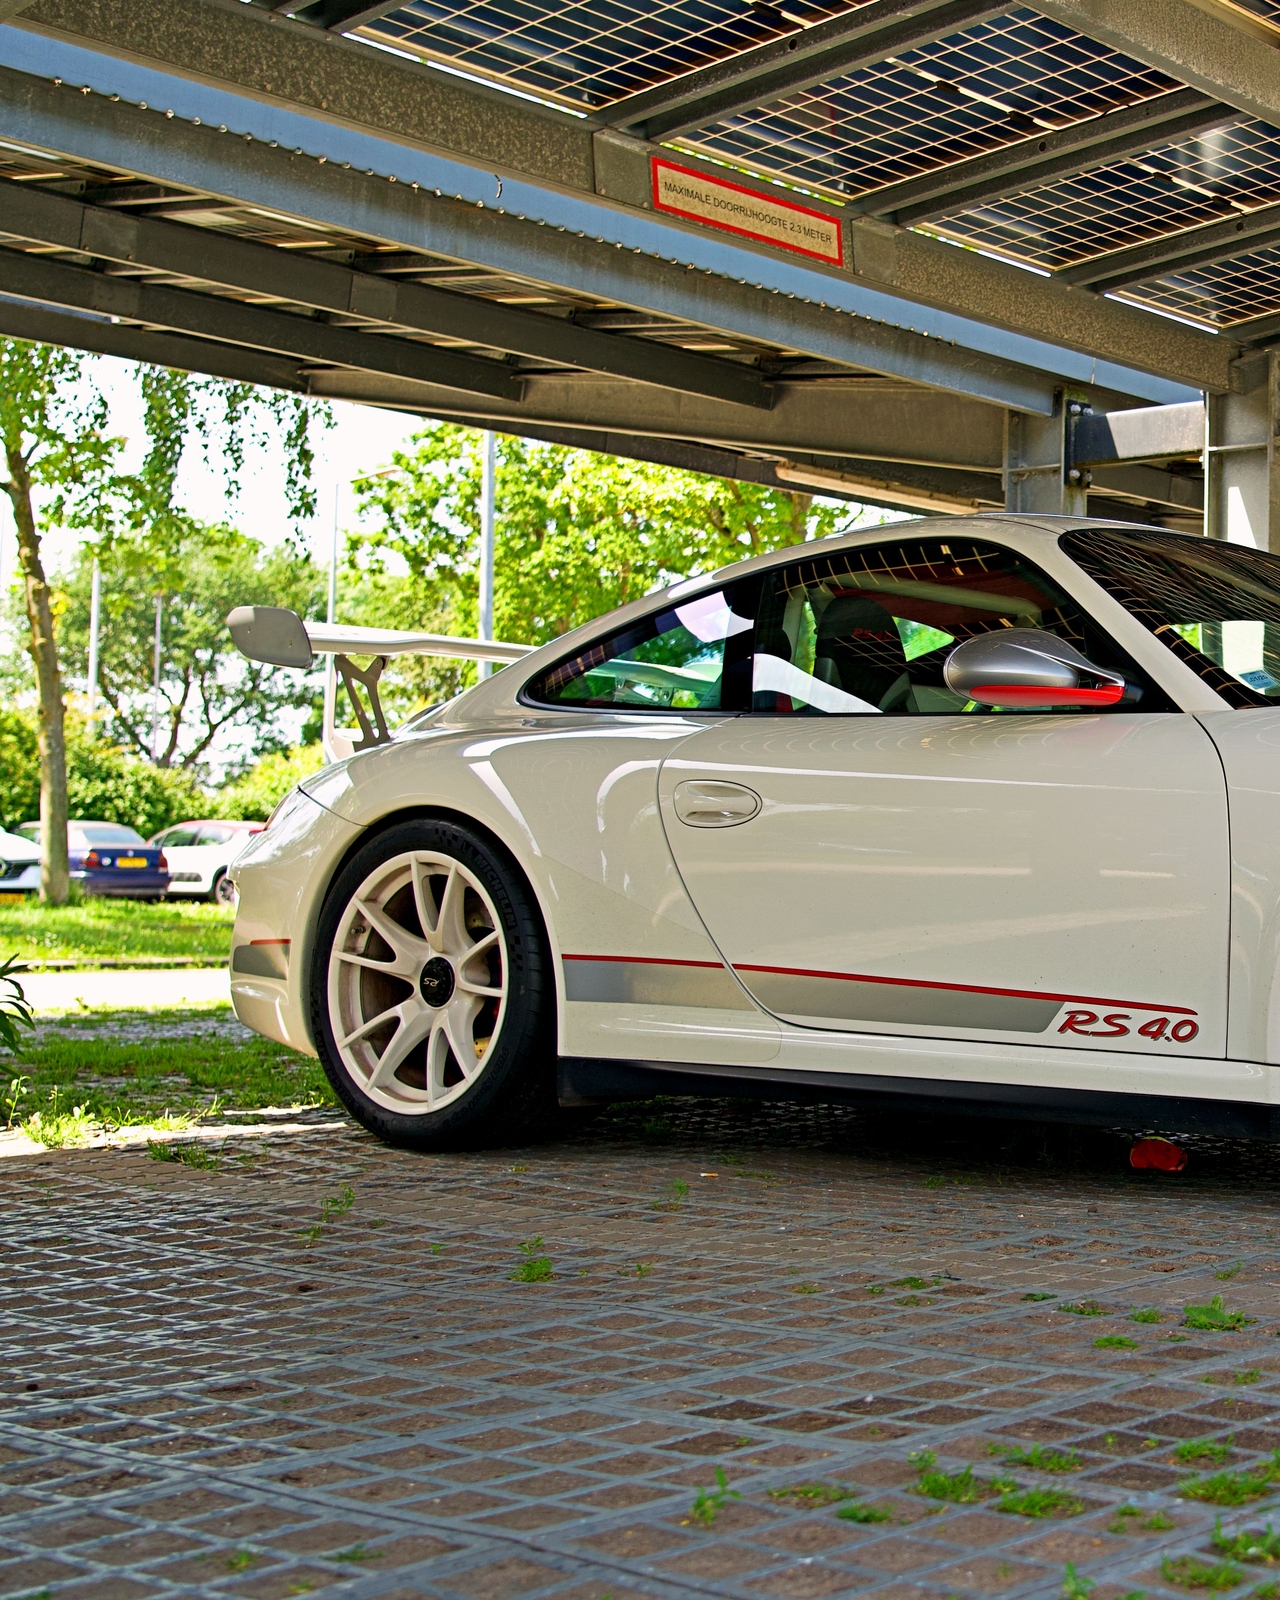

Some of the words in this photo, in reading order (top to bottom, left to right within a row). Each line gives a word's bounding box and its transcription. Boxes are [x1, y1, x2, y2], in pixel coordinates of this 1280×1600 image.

[664, 181, 711, 205] MAXIMALE
[713, 197, 788, 231] DOORRIJHOOGTE
[789, 222, 802, 235] 2.3
[803, 226, 832, 244] METER
[473, 852, 518, 930] MICHELIN
[1057, 1010, 1132, 1037] RS
[1137, 1016, 1199, 1042] 4.0
